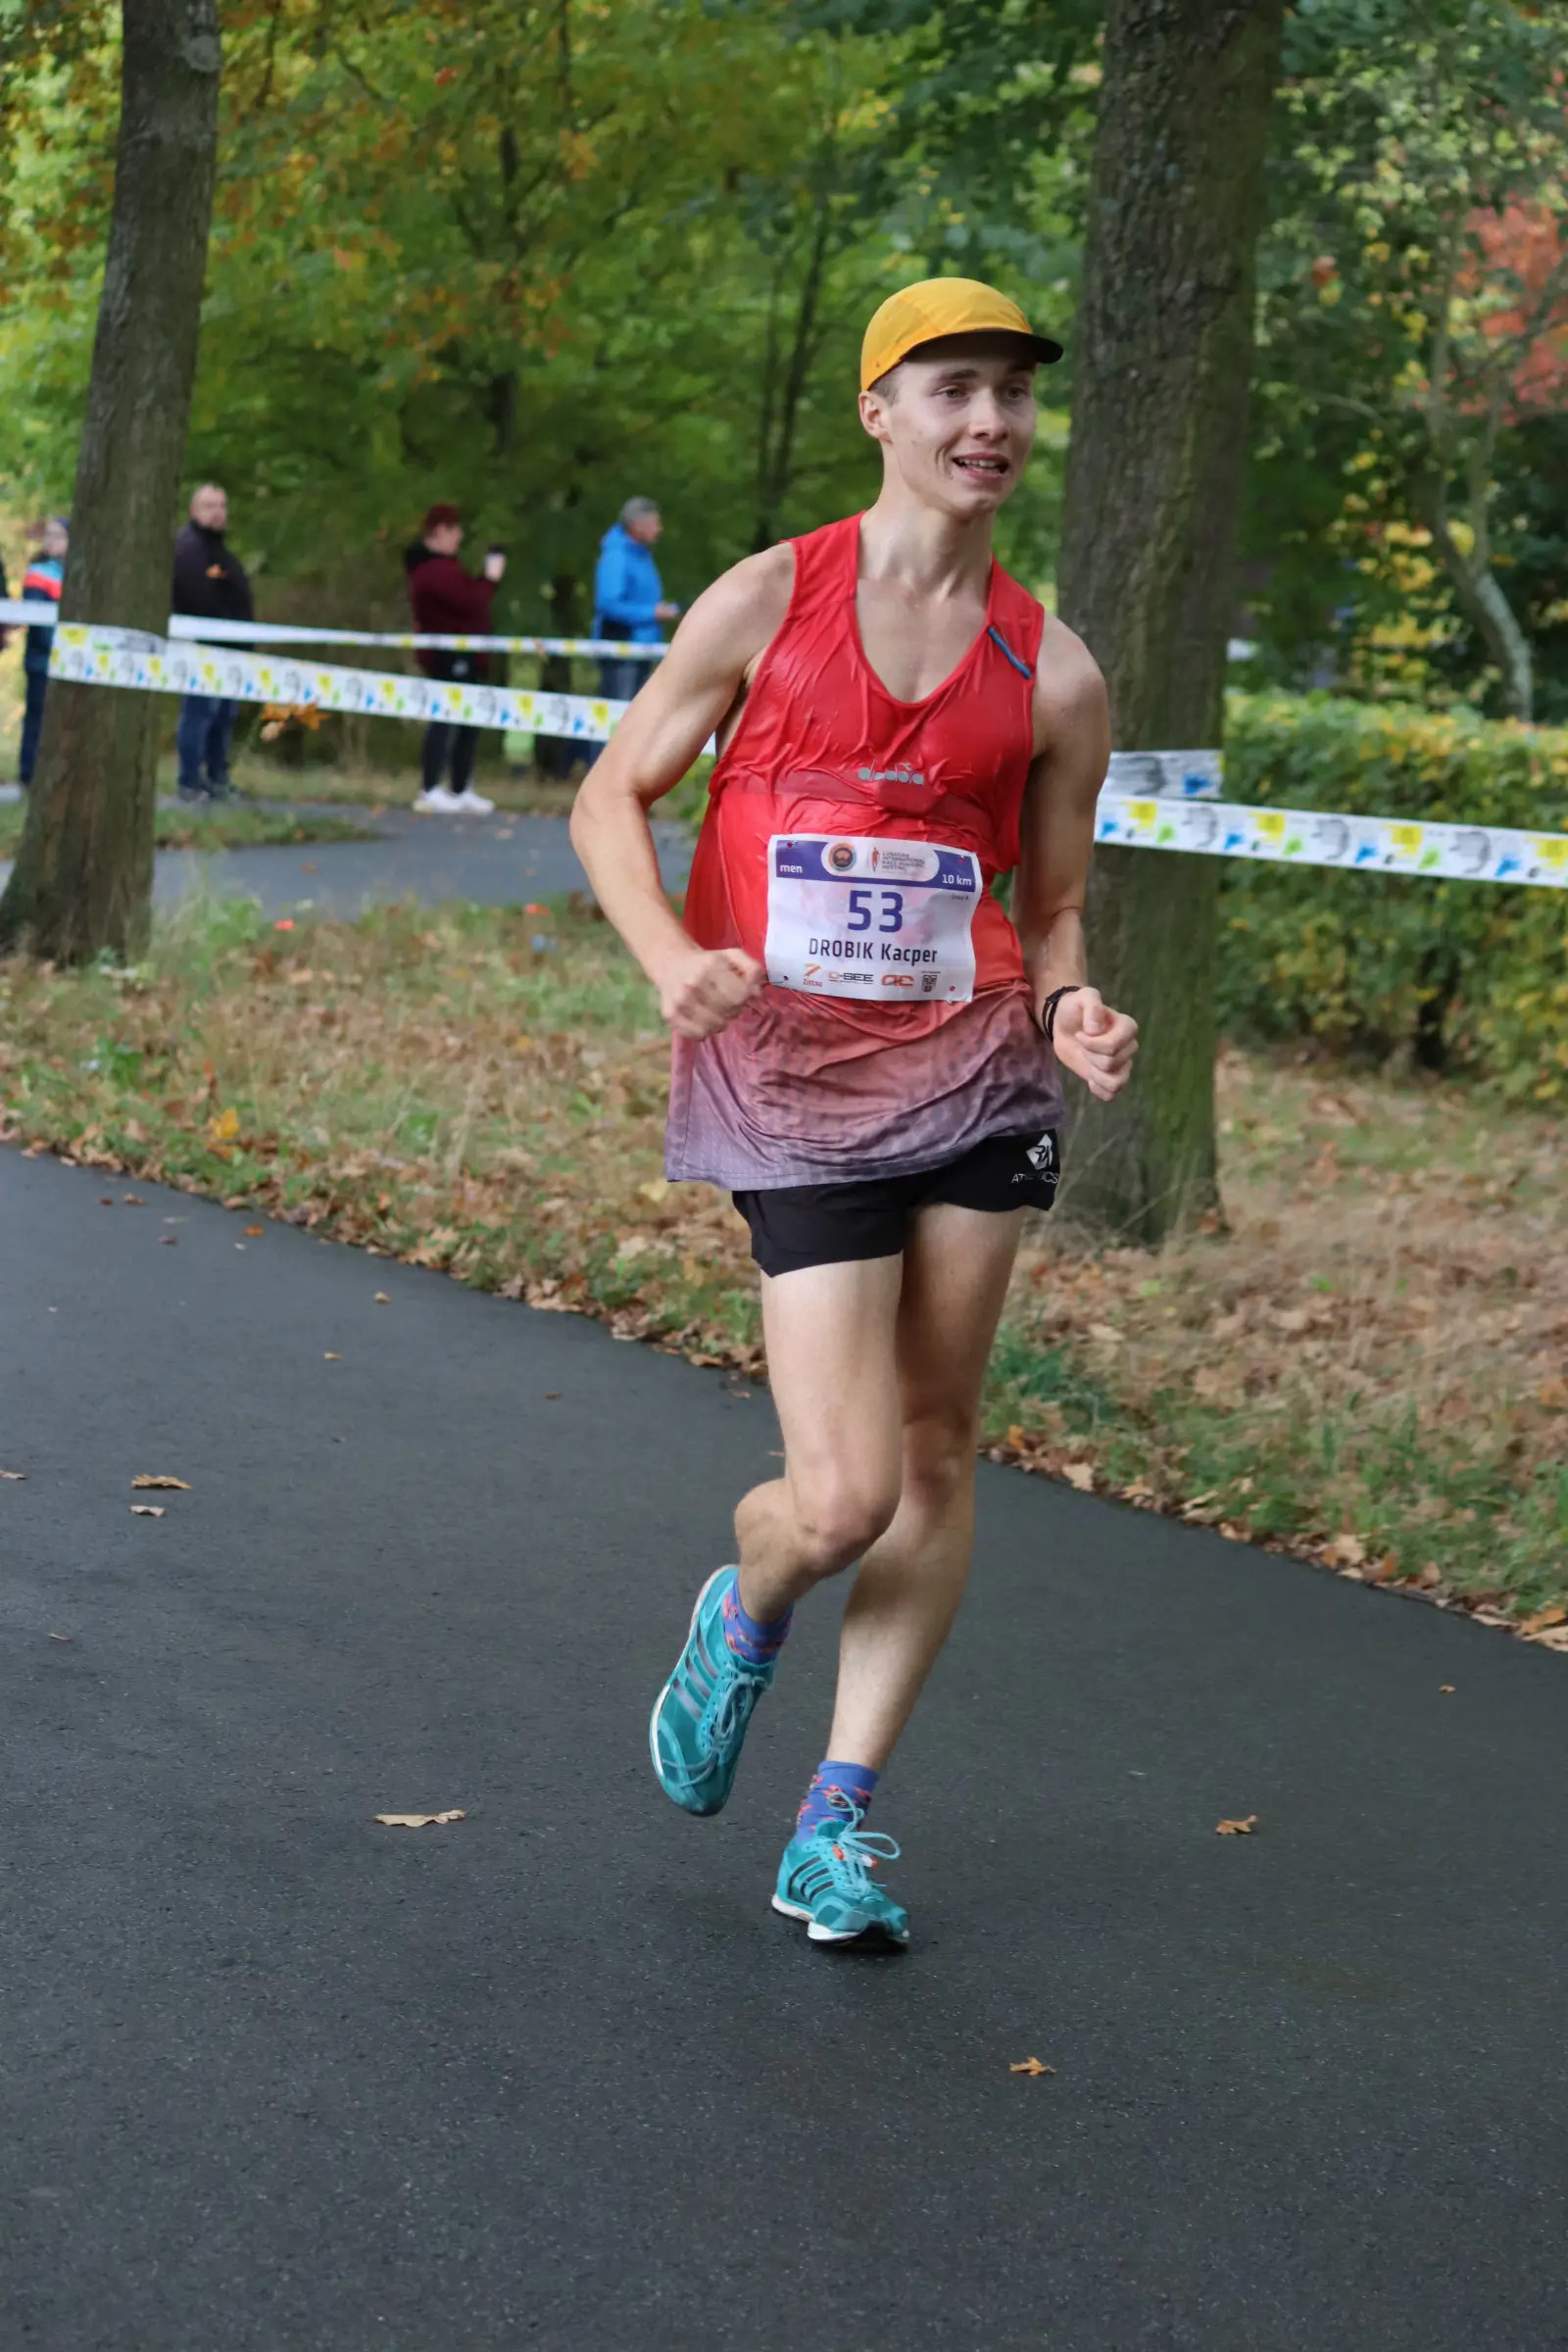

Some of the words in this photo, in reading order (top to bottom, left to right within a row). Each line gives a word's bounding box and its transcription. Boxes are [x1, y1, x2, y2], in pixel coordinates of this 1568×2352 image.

[779, 863, 803, 874] men
[942, 874, 955, 884] 10
[956, 875, 972, 886] km
[847, 889, 904, 933] 53
[808, 938, 873, 960] DROBIK
[881, 943, 939, 966] Kacper
